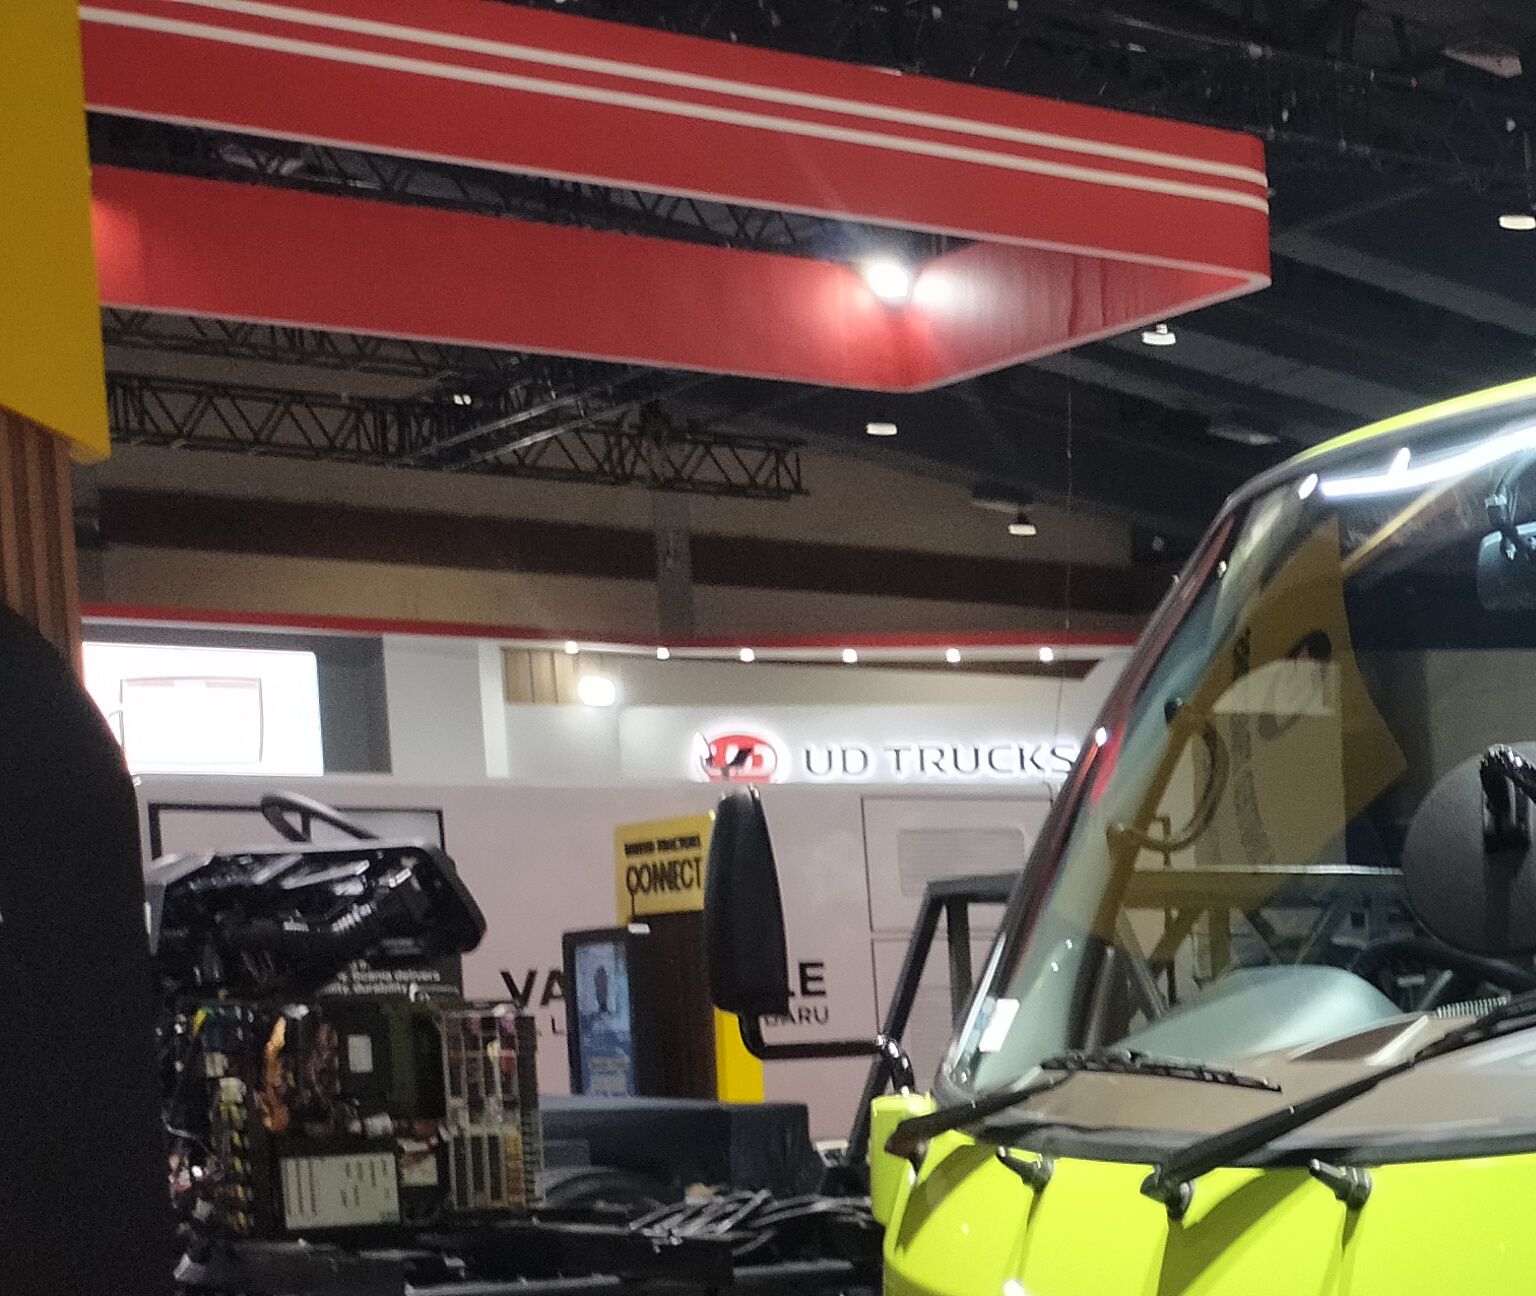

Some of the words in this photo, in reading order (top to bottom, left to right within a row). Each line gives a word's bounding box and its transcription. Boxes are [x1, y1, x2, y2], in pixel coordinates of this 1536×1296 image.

[804, 745, 869, 776] UD
[883, 742, 1078, 778] TRUCKS
[625, 856, 702, 896] CONNECT
